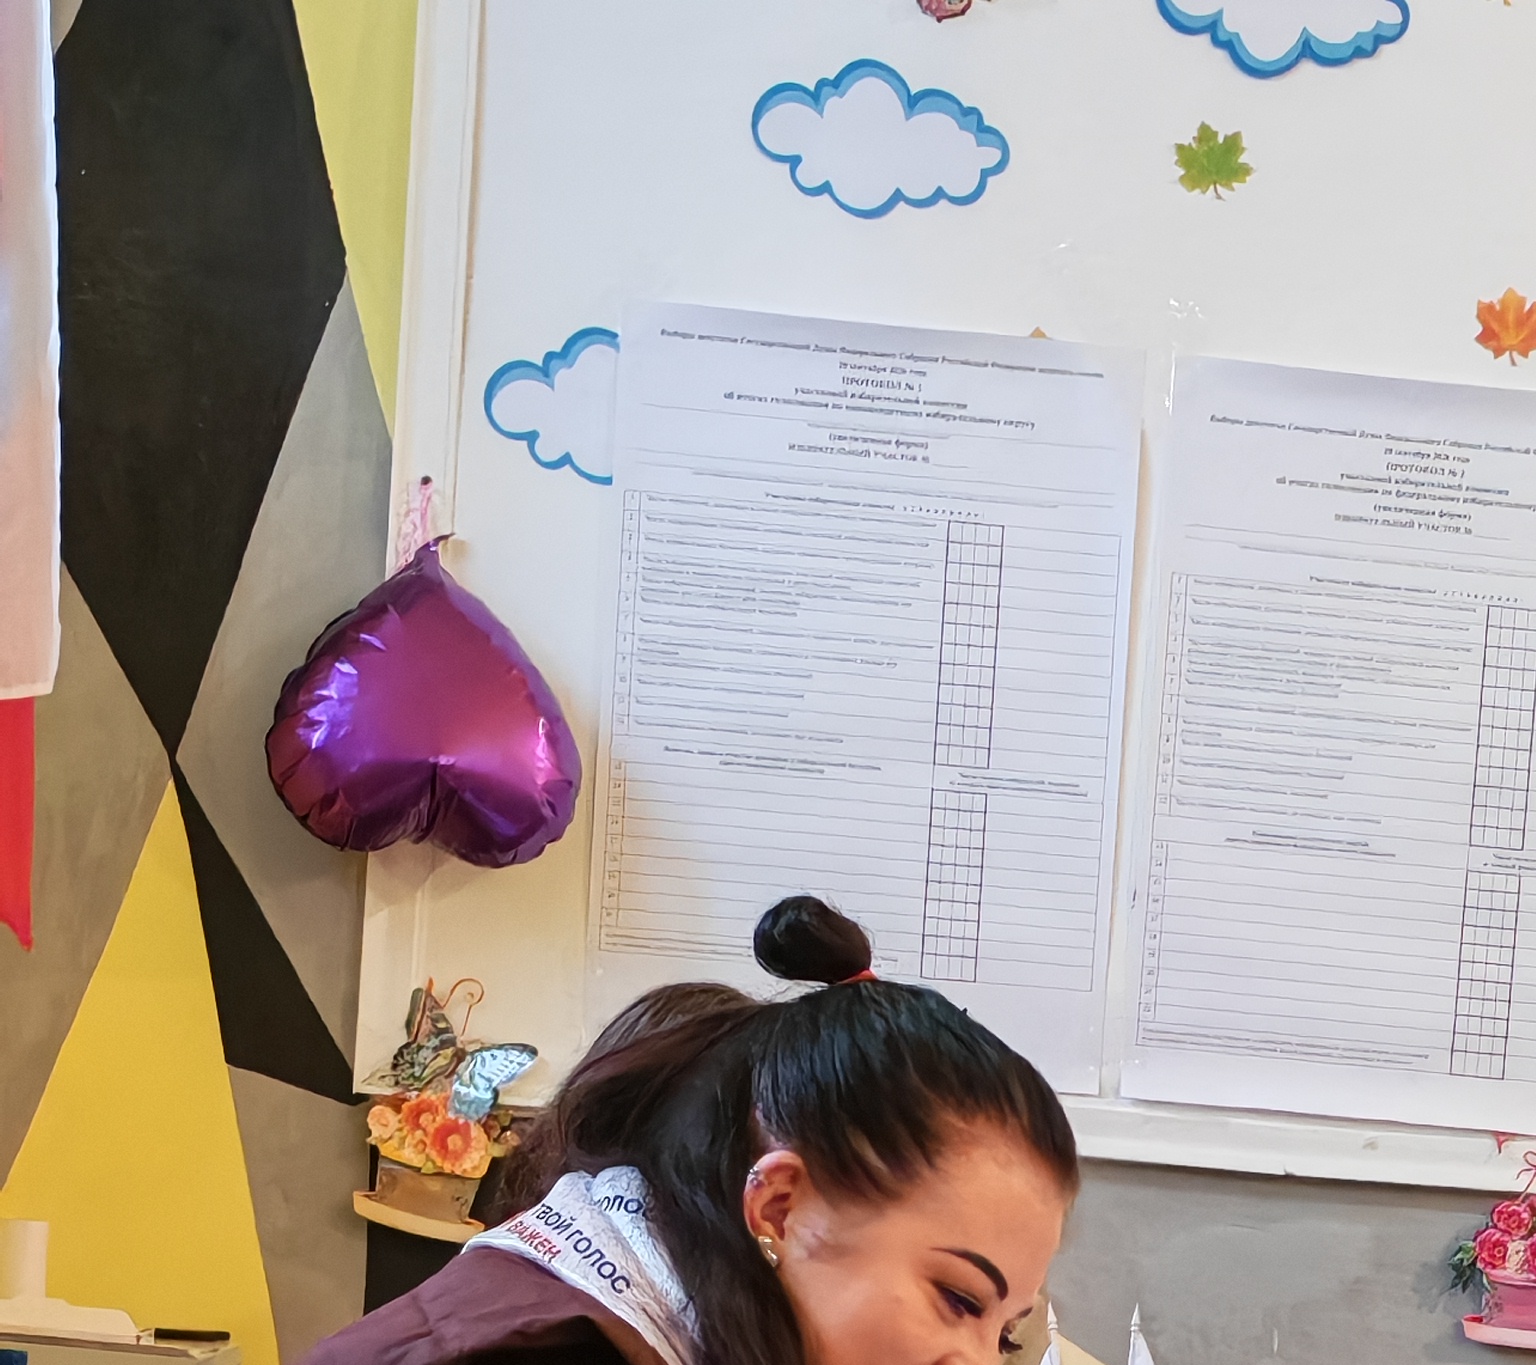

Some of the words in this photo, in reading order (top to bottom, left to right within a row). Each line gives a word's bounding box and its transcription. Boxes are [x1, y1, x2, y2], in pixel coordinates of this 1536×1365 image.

[506, 1220, 562, 1264] ВАЖЕН
[531, 1203, 577, 1236] ТВОЙ
[565, 1229, 631, 1294] ГОЛОС
